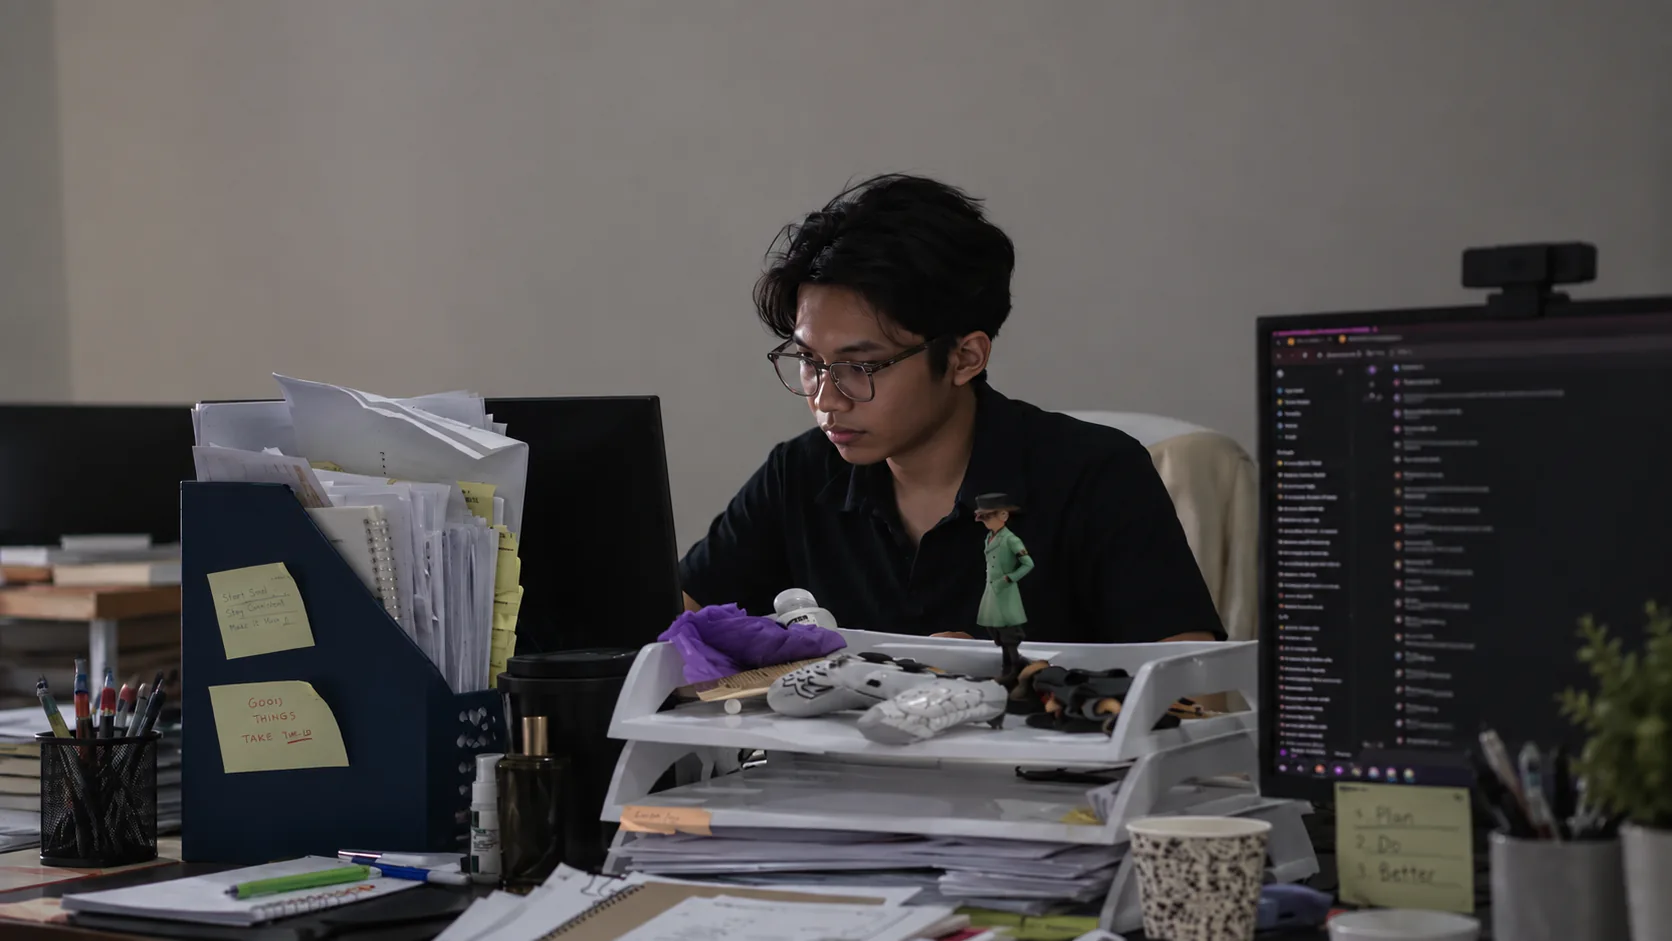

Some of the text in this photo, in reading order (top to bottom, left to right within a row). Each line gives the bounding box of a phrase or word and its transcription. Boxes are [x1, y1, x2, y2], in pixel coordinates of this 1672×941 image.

[222, 590, 245, 603] Start
[225, 608, 244, 620] Stay
[252, 711, 296, 724] THINGS
[241, 732, 274, 744] TAKE
[1376, 805, 1415, 825] Plan
[1377, 834, 1402, 854] Do
[1379, 860, 1436, 883] Better
